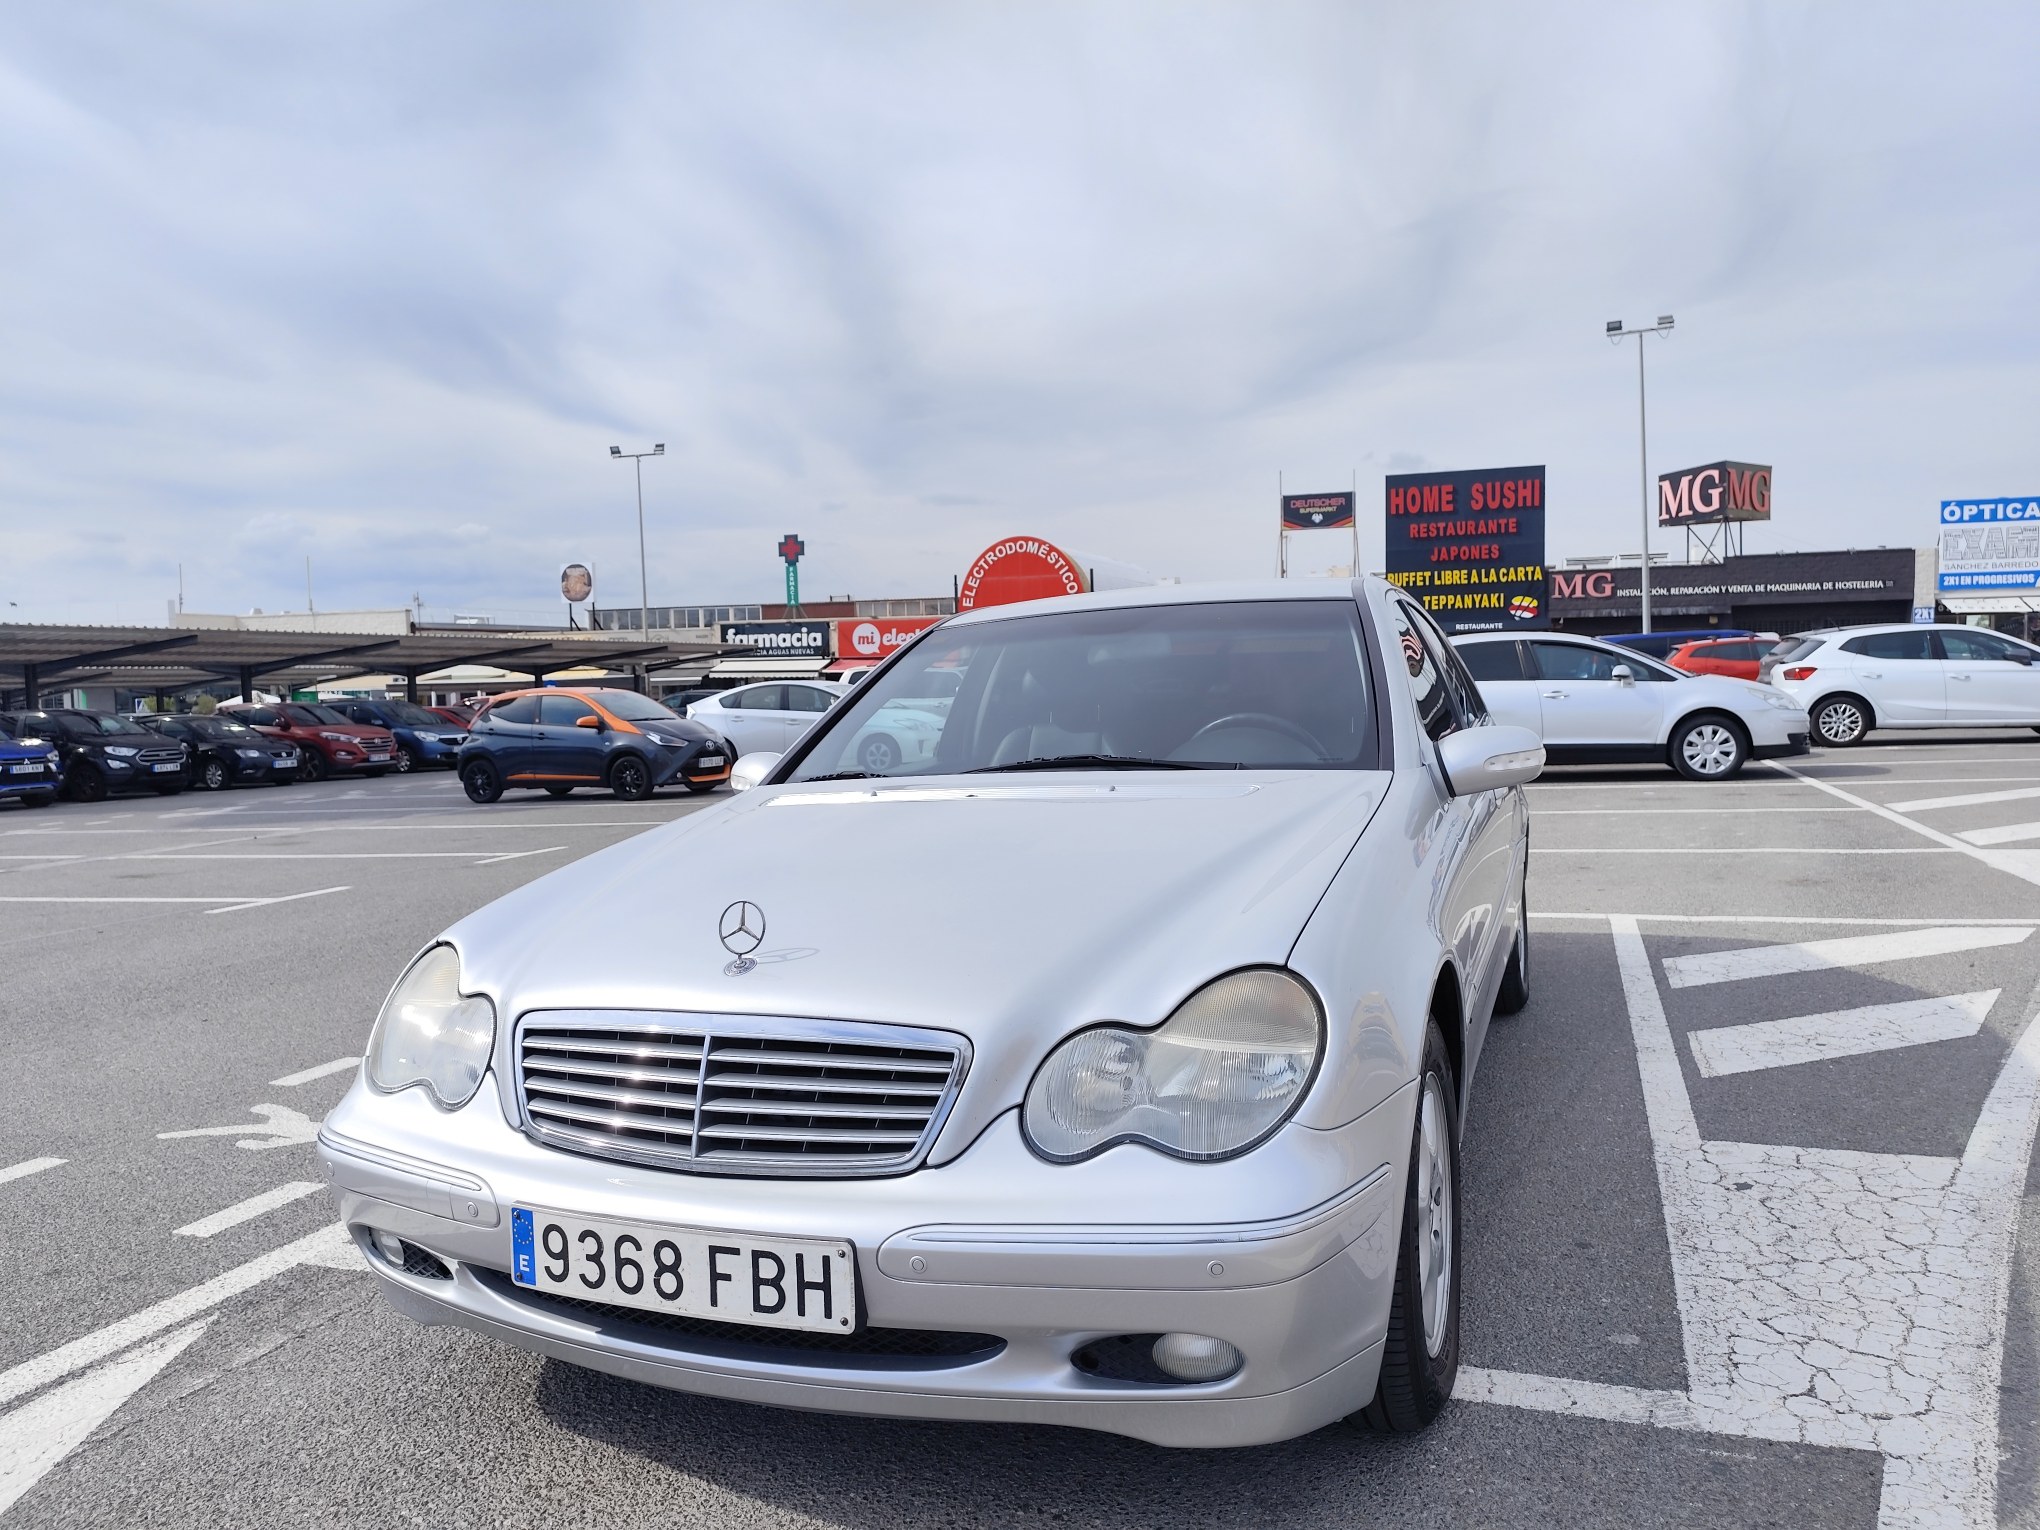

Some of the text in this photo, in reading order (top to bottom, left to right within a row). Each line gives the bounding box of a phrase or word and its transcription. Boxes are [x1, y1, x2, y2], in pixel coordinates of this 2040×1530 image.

[1390, 479, 1540, 515] HOME SUSHI
[1659, 468, 1724, 521] MG
[1727, 467, 1770, 514] MG
[1290, 497, 1346, 509] DEUTSCHER
[1299, 506, 1338, 514] SUPERMARKT
[1943, 501, 2040, 522] ÓPTICA
[1409, 518, 1517, 538] RESTAURANTE
[1430, 543, 1500, 562] JAPONES
[1991, 560, 2039, 569] BARREDO
[1434, 569, 1468, 586] LIBRE
[1470, 568, 1479, 584] A
[1481, 567, 1498, 583] LA
[1499, 565, 1543, 582] CARTA
[1943, 573, 2035, 586] 2X1 EN PROGRESIVOS
[1551, 572, 1616, 599] MG
[1671, 584, 1719, 596] REPARACIÓN
[1721, 584, 1726, 593] Y
[1728, 584, 1753, 593] VENTA
[1755, 583, 1765, 592] DE
[1767, 582, 1820, 592] MAQUINARIA
[1823, 581, 1833, 590] DE
[1423, 593, 1505, 610] TEPPANYAKI
[1914, 608, 1934, 619] 2X1
[1455, 622, 1503, 631] RESTAURANTE
[726, 627, 822, 648] farmacia
[857, 631, 876, 645] mi
[790, 647, 814, 655] NUEVAS
[519, 1255, 530, 1272] E
[541, 1223, 685, 1302] 9368
[708, 1244, 833, 1320] FBH
